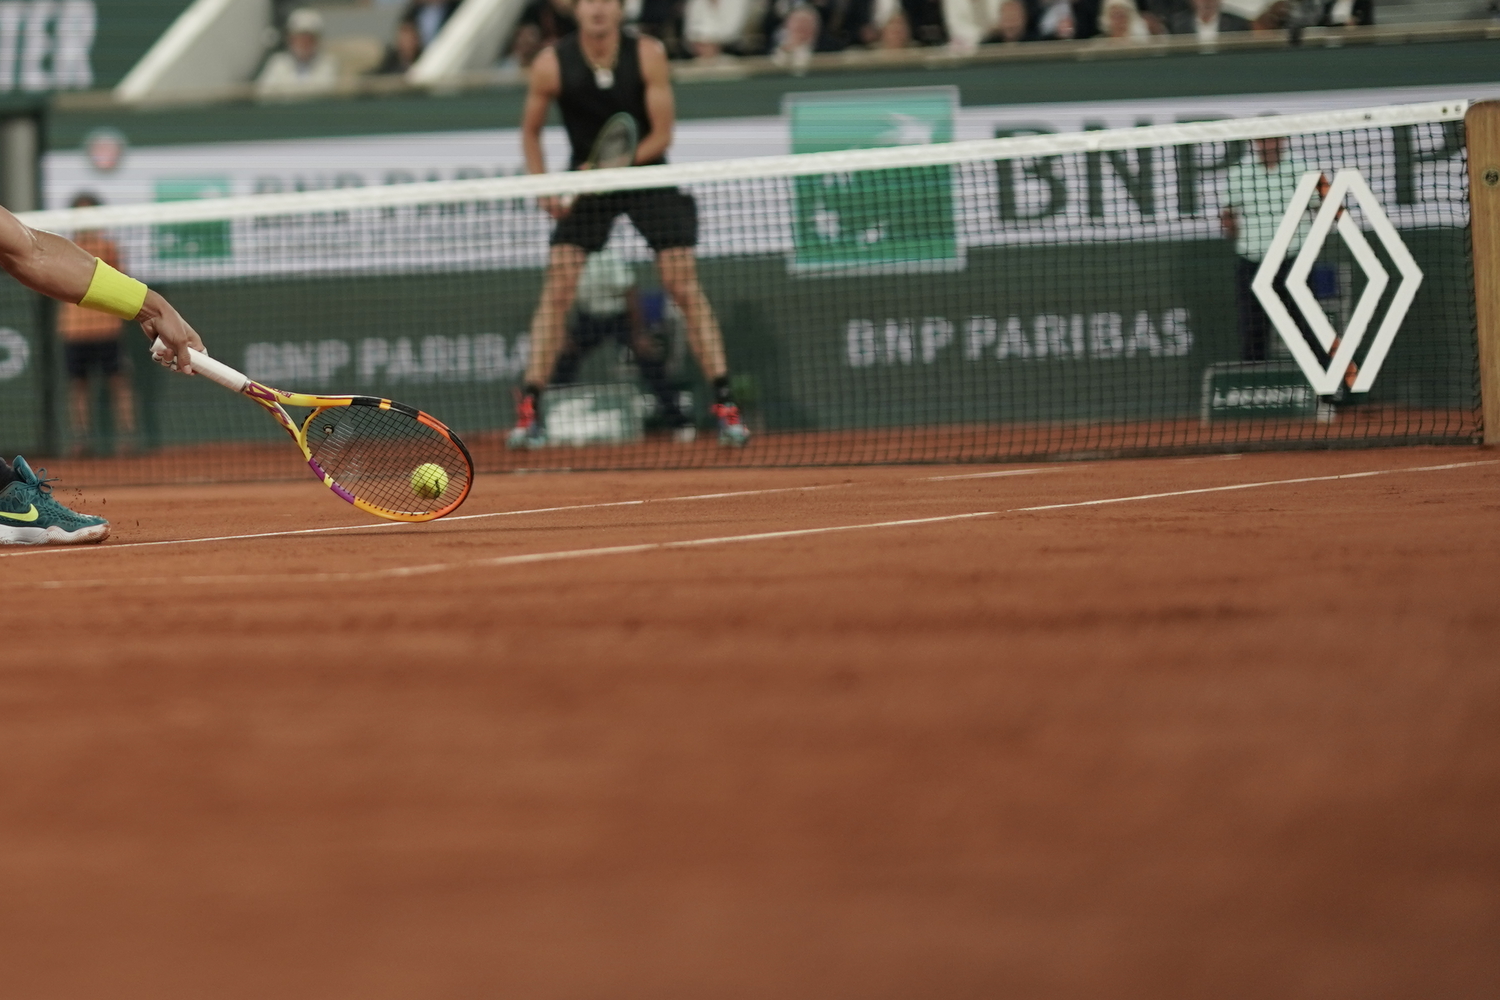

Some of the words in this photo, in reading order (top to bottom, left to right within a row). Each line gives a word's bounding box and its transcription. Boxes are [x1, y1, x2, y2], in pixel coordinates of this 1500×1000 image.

[994, 110, 1248, 221] BNP
[244, 341, 349, 384] BNP
[845, 317, 955, 366] BNP
[964, 305, 1193, 362] PARIBAS
